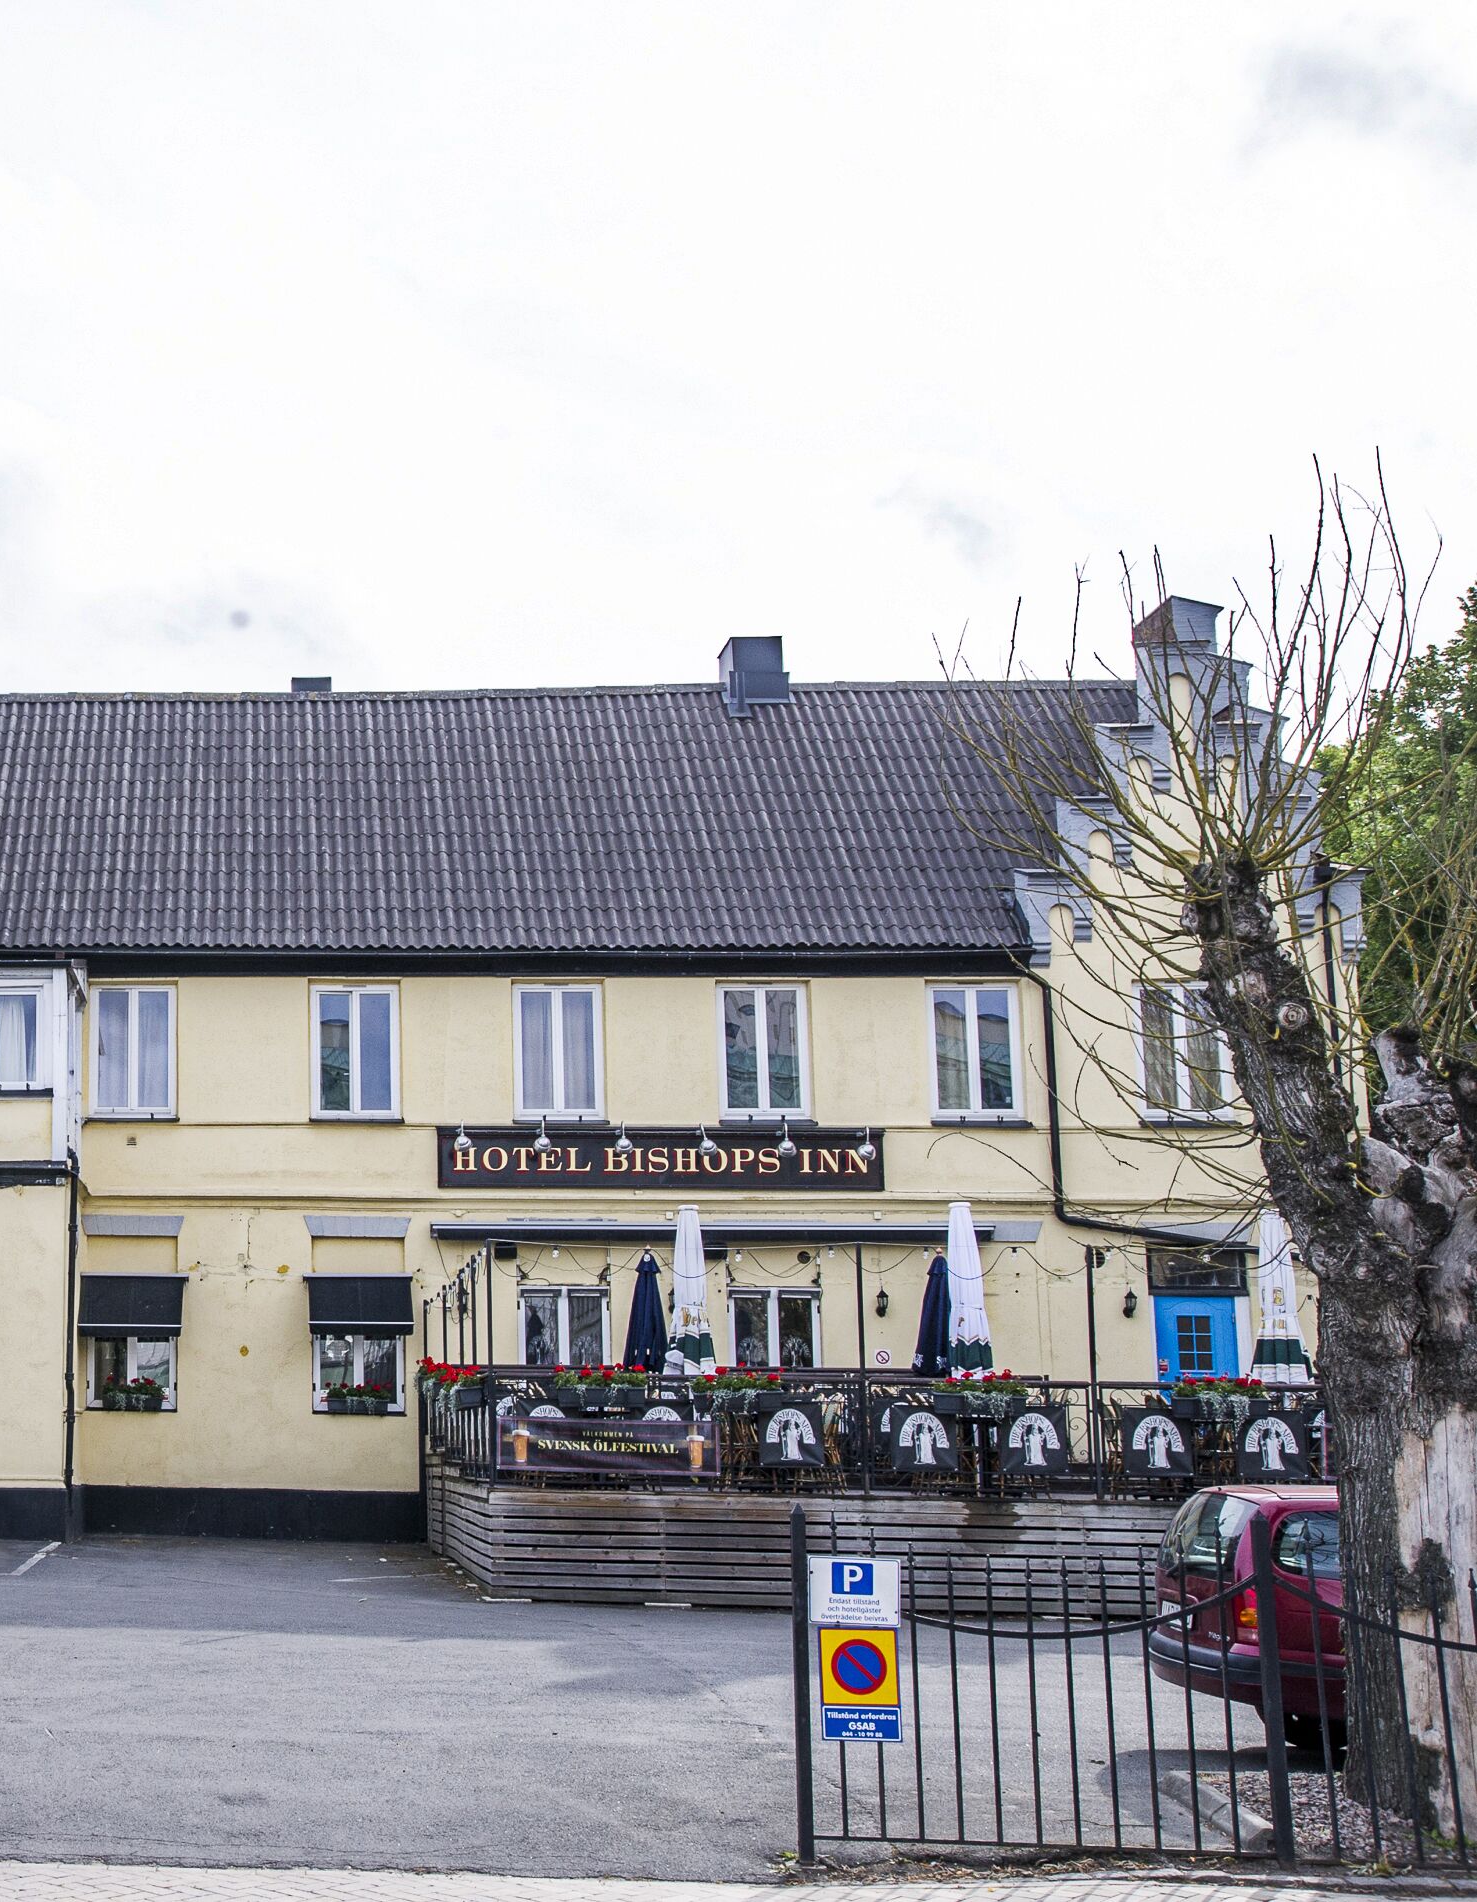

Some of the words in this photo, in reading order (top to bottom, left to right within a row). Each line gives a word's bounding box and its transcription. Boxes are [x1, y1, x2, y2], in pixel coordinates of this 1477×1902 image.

[452, 1146, 591, 1172] HOTEL
[604, 1146, 781, 1174] BISHOPS
[799, 1147, 869, 1174] INN
[537, 1439, 591, 1452] SVENSK
[593, 1439, 679, 1454] ÖLFESTIVAL
[843, 1564, 864, 1592] P
[829, 1597, 851, 1605] Endast
[841, 1606, 882, 1615] hotellgäster
[821, 1613, 862, 1621] överträdelse
[864, 1614, 888, 1622] beivras
[827, 1711, 859, 1720] Tillstånd
[861, 1712, 897, 1721] erfordras
[848, 1721, 876, 1731] GSAB
